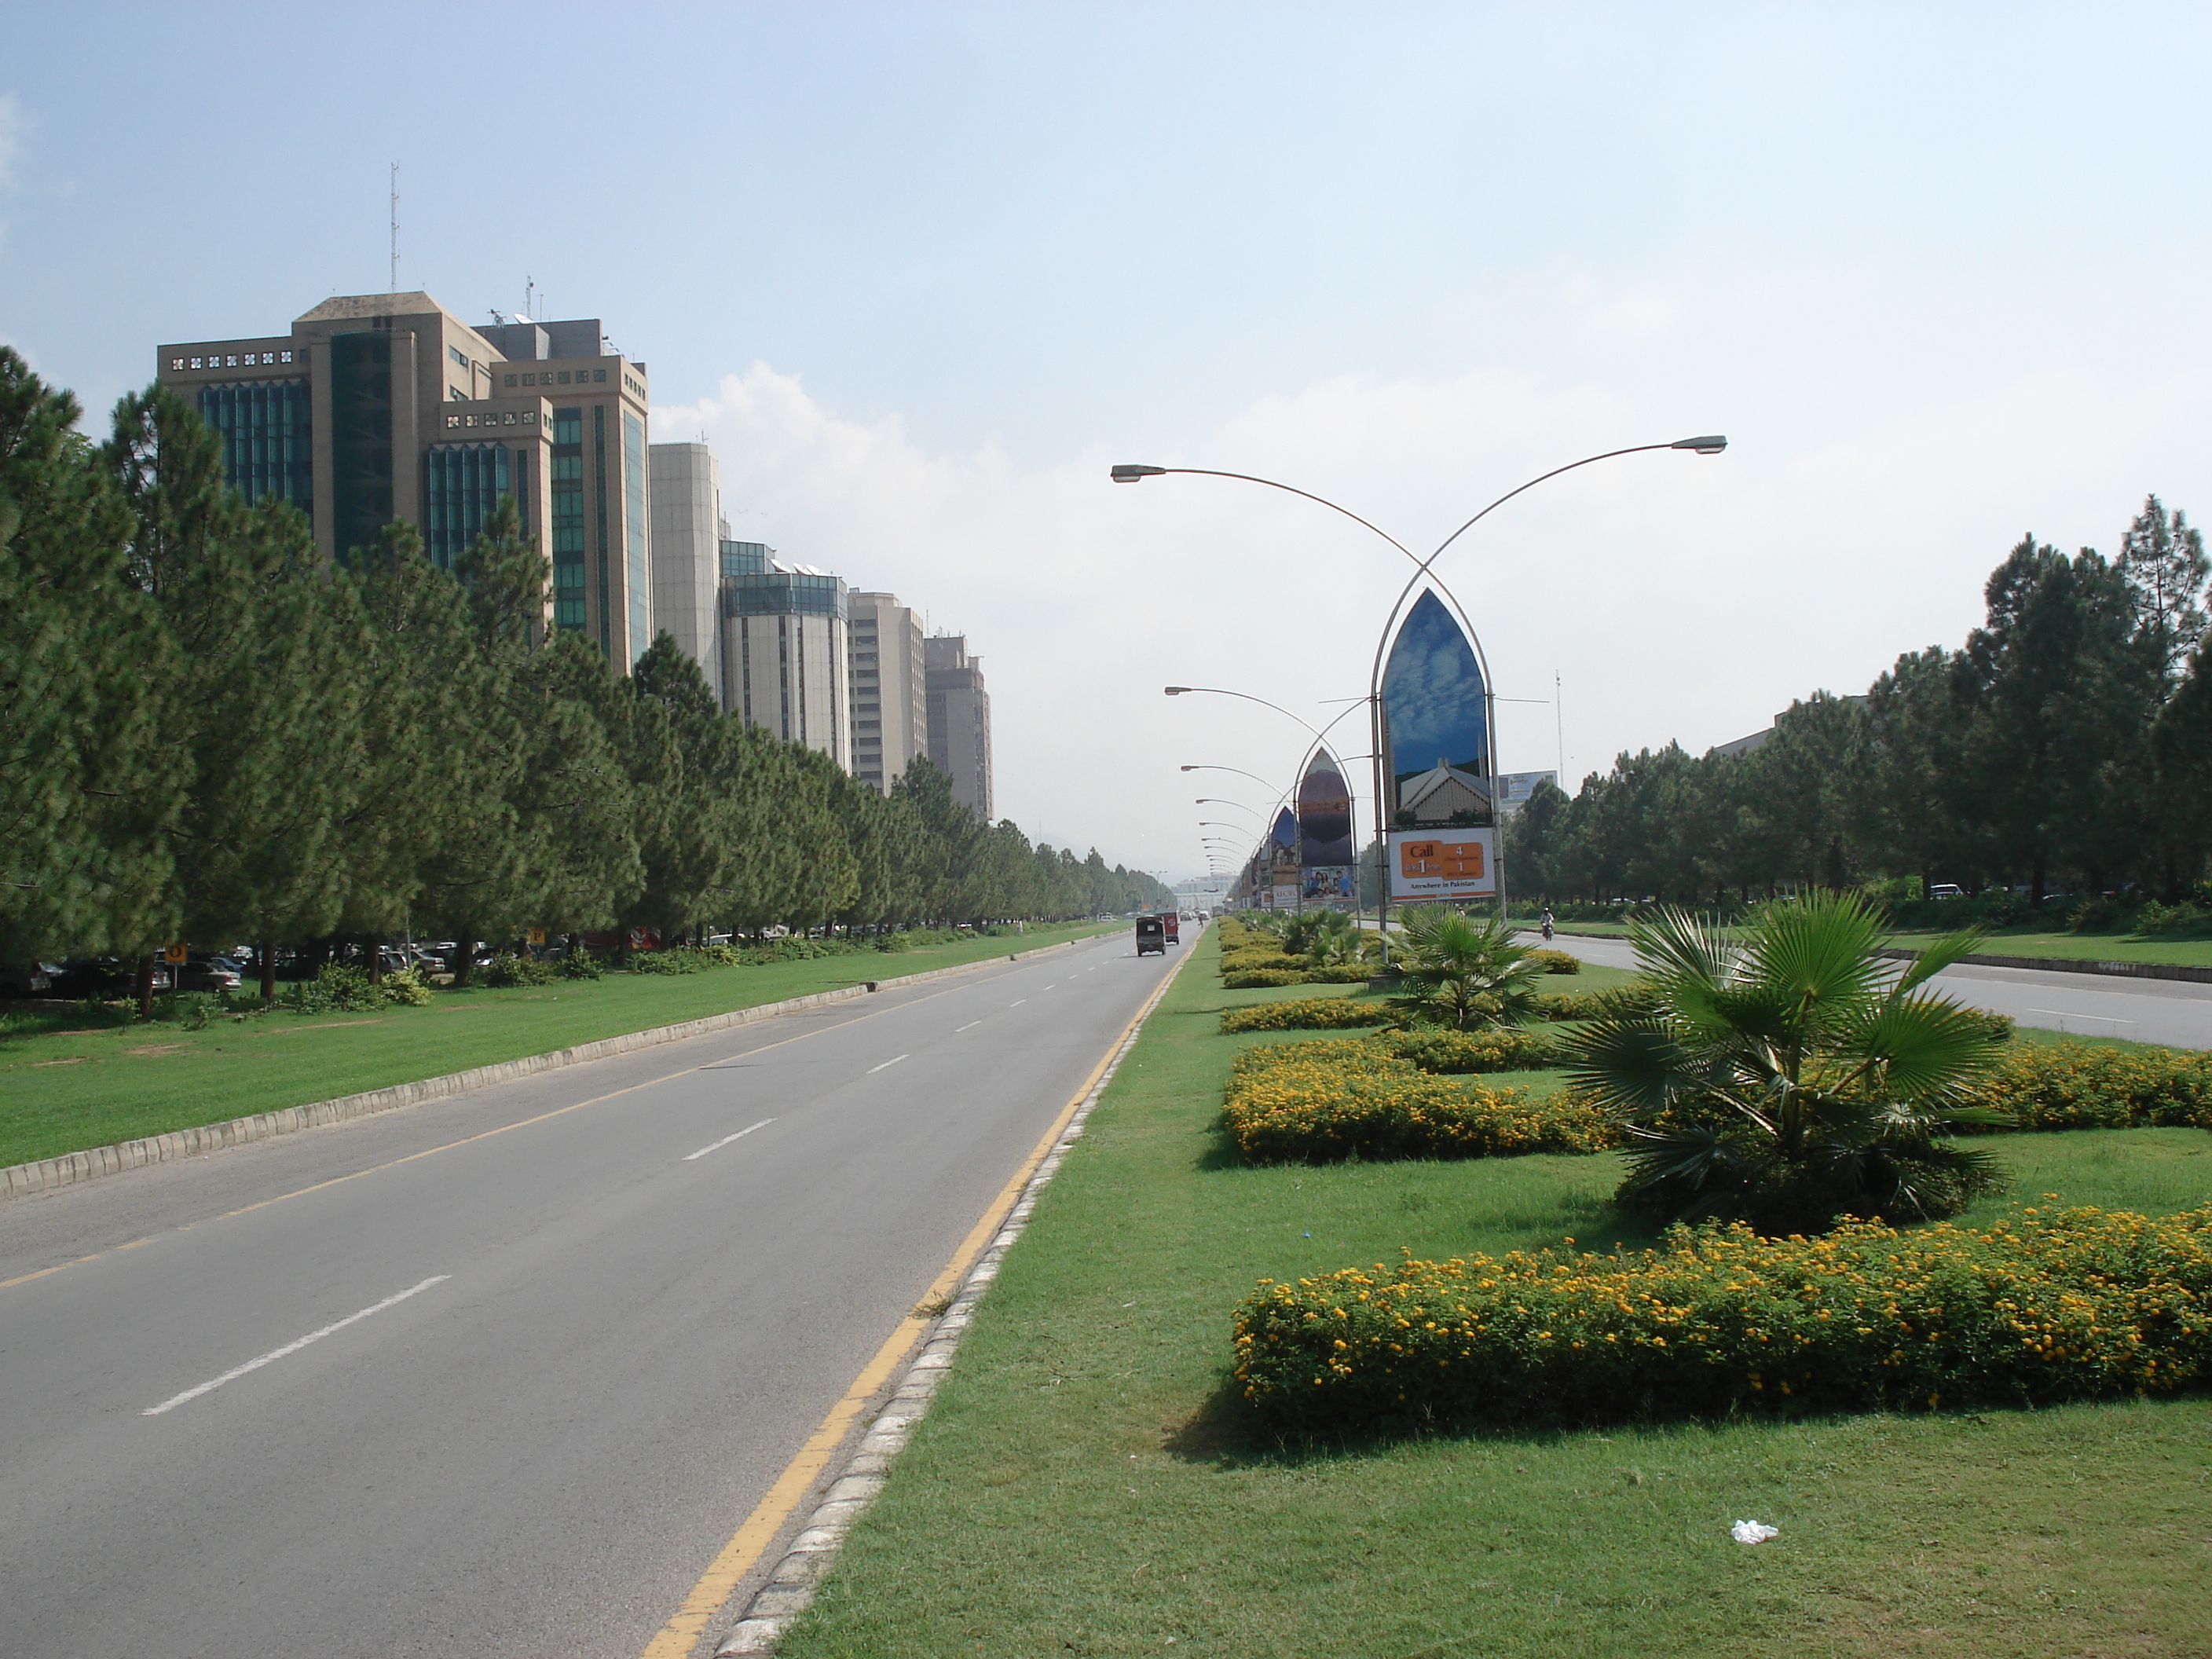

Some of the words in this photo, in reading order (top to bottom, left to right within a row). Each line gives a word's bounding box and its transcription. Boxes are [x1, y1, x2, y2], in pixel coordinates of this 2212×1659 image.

[1410, 844, 1434, 858] Call
[1456, 846, 1463, 855] 4
[1458, 862, 1463, 871] 1
